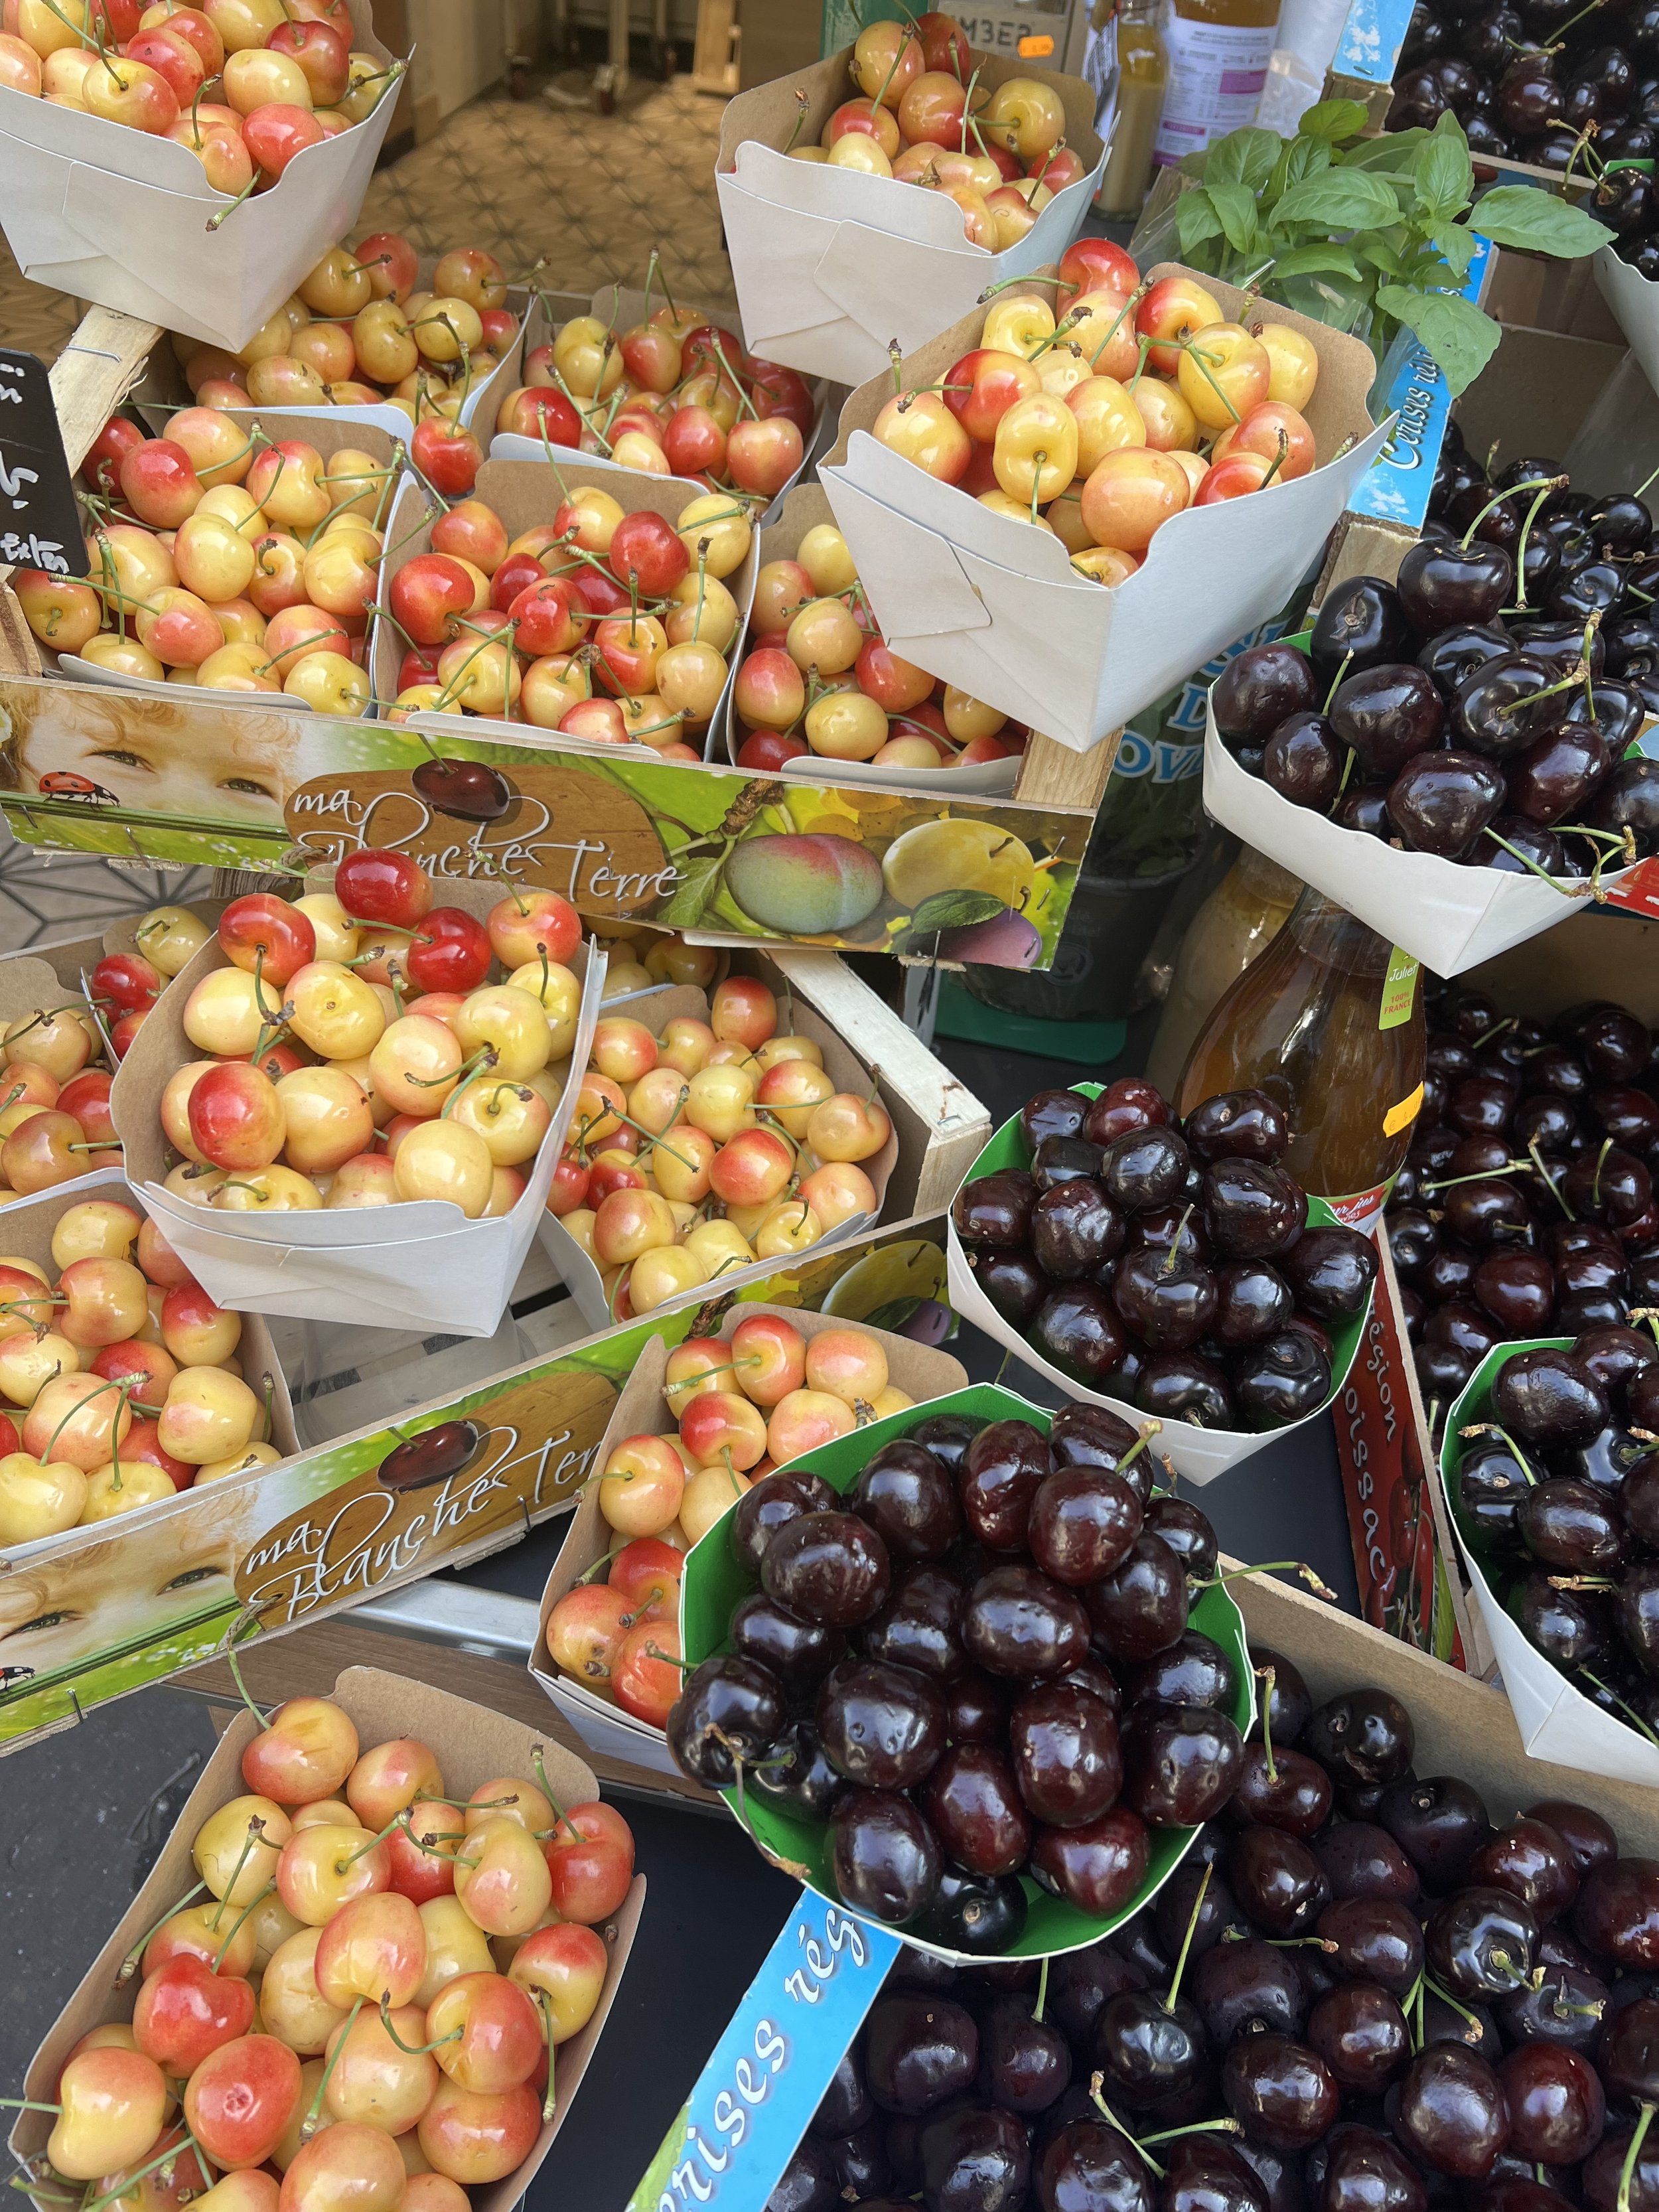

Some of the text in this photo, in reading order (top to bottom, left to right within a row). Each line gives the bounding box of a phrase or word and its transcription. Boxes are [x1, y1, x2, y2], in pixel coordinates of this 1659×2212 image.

[1377, 387, 1432, 471] Cerises
[293, 789, 362, 816] ma
[527, 839, 687, 902] Terre
[1389, 962, 1418, 982] Juliet
[1391, 991, 1410, 1003] 100%
[1384, 997, 1412, 1015] FRANCE
[1342, 1387, 1386, 1582] oissac
[246, 1520, 321, 1575] ma
[248, 1426, 601, 1621] Planche Ter
[784, 1907, 865, 2004] rég
